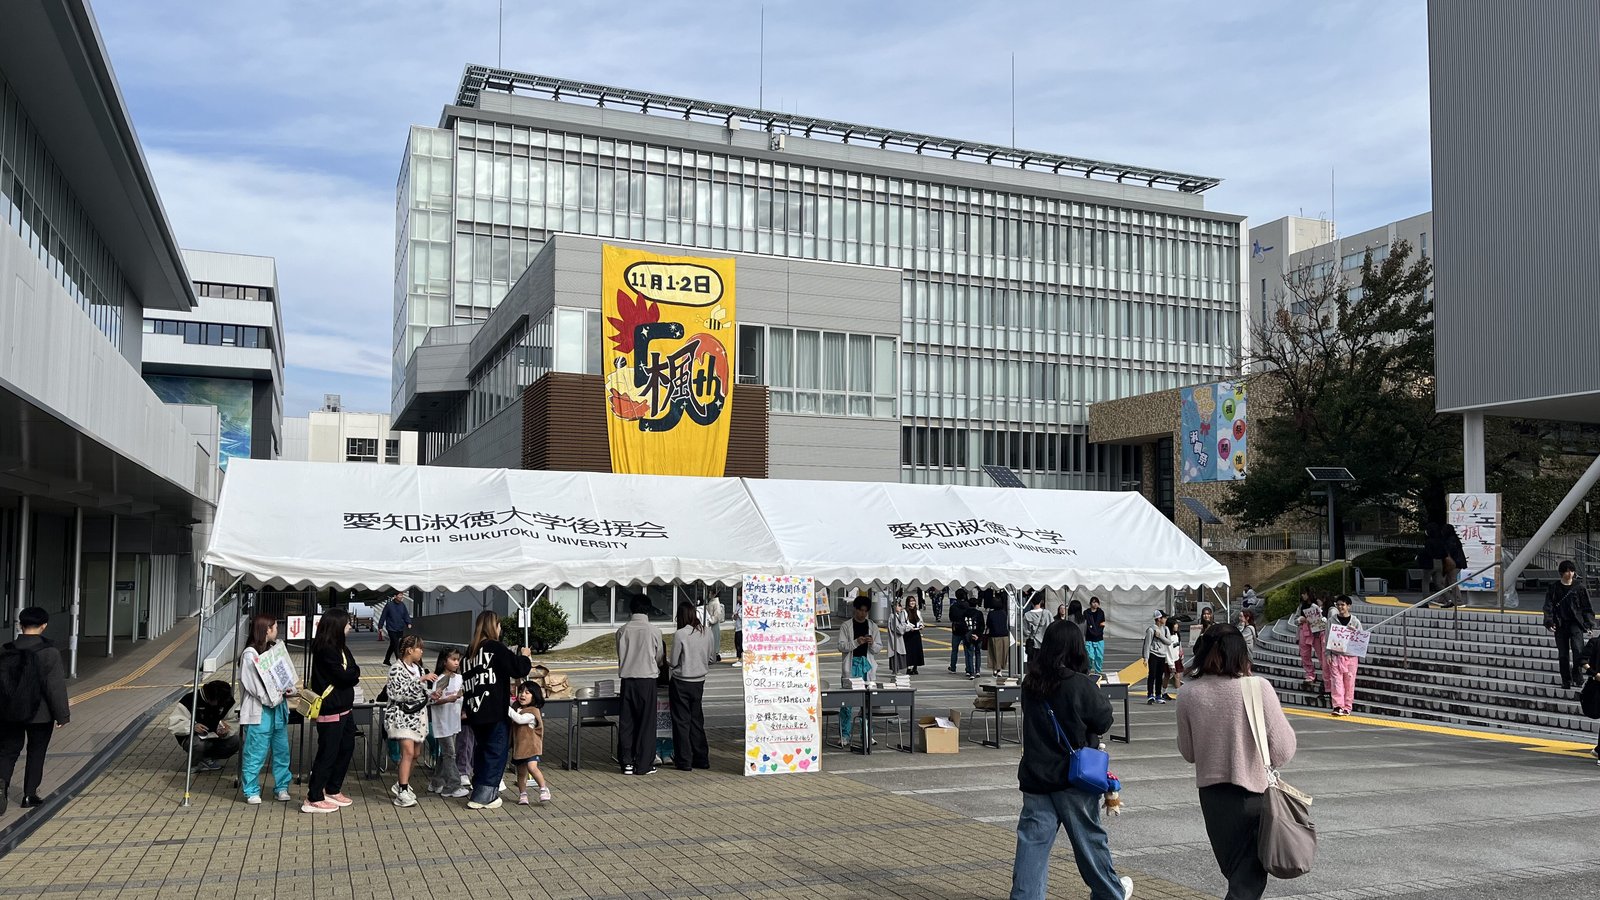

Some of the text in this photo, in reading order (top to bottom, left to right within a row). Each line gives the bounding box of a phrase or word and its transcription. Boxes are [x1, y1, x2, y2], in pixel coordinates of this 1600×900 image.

[343, 506, 669, 539] 愛知淑徳大学後援会
[887, 518, 1066, 545] 愛知淑徳大学
[400, 527, 628, 549] AICHI SHUKUTOKU UNIVERSITY
[901, 537, 1078, 556] AICHI SHUKUTOKU UNIVERSITY
[746, 582, 768, 594] 学内生
